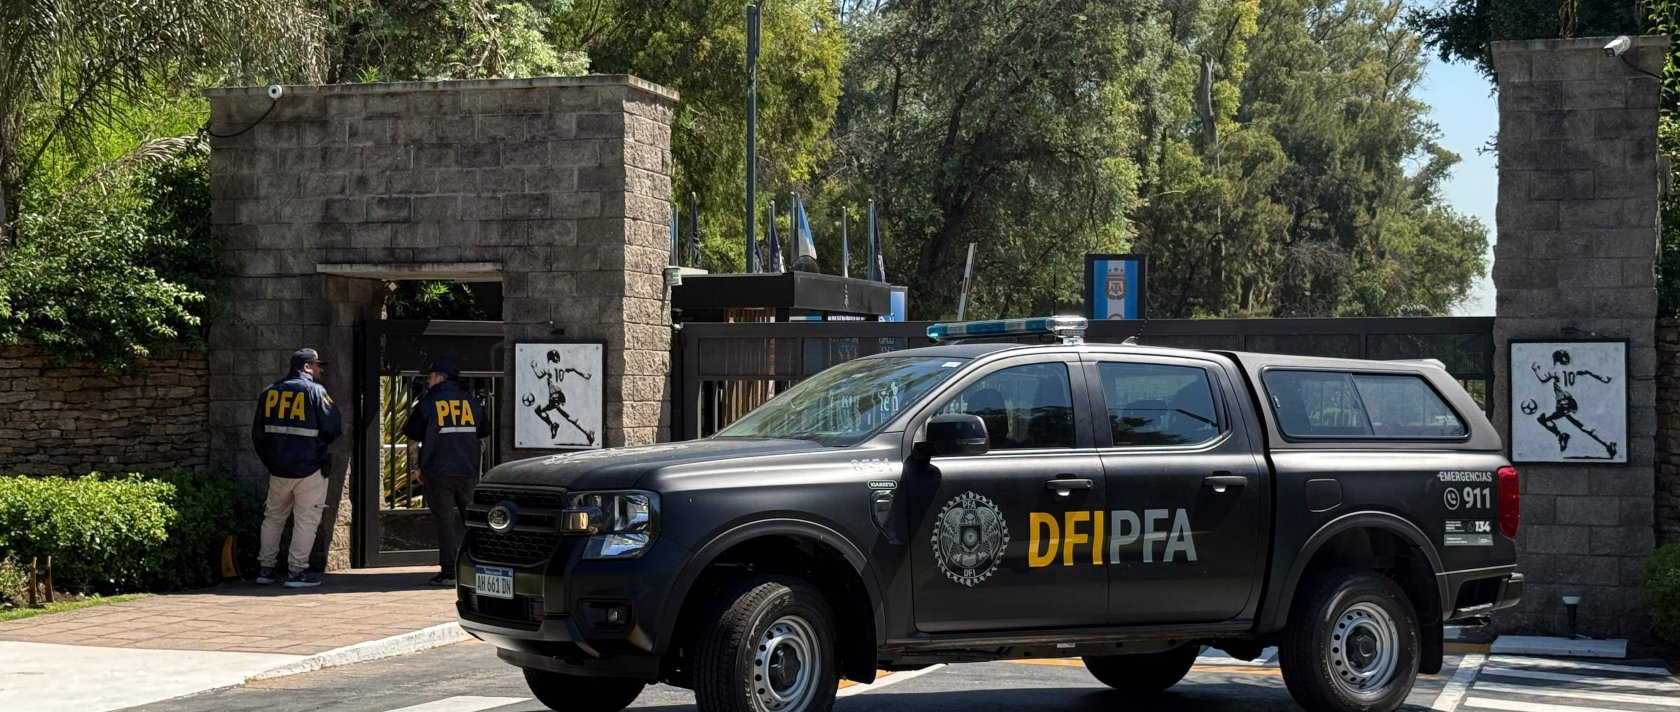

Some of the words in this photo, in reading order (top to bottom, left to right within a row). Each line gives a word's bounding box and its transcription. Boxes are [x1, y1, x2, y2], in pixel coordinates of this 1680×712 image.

[554, 368, 565, 382] 10
[1562, 370, 1576, 387] 10
[265, 389, 306, 421] PFA
[435, 399, 475, 426] PFA
[1439, 471, 1492, 482] EMERGENCIAS
[962, 501, 976, 509] PFA
[1463, 486, 1490, 509] 911
[963, 569, 975, 577] DFI
[478, 575, 486, 592] AH
[487, 576, 500, 593] 661
